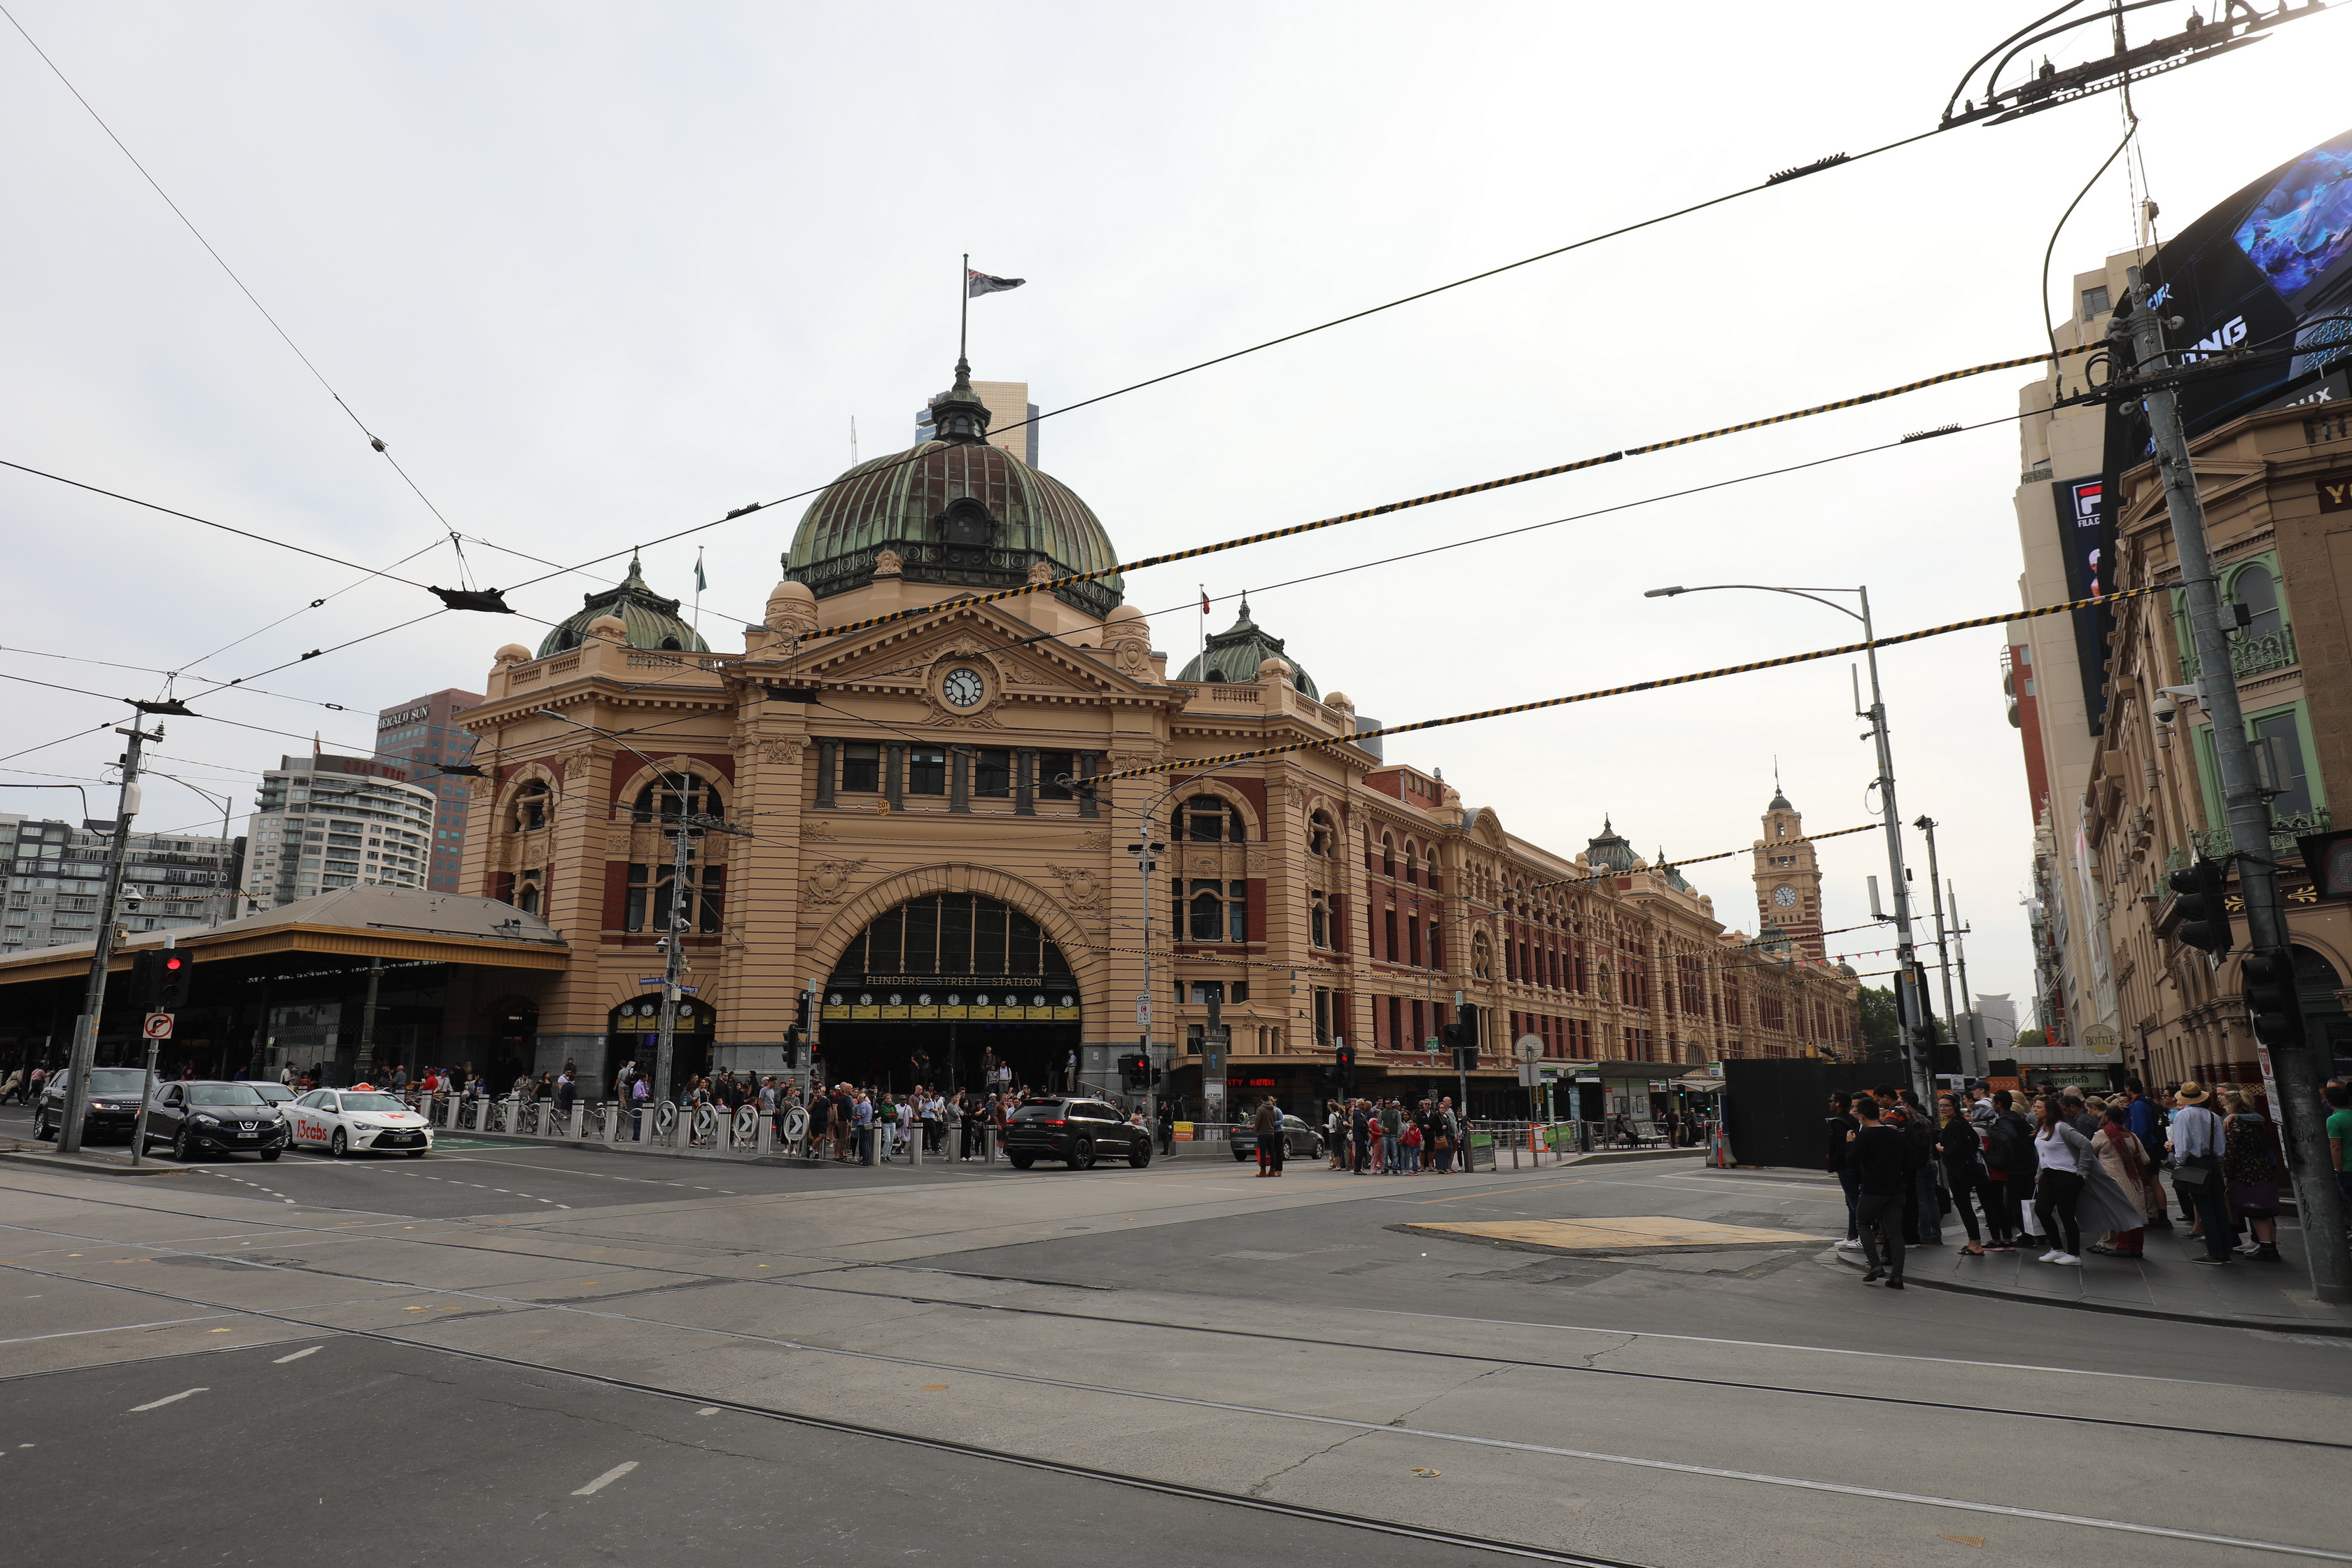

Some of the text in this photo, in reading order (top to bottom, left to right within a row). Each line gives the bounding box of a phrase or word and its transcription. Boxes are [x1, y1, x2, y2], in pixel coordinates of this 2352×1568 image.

[2325, 483, 2352, 504] Y
[378, 706, 428, 729] HERALD SUN
[343, 760, 406, 782] QUAY WEST
[866, 976, 1042, 987] FLINDERS STREET STATION
[2085, 1035, 2116, 1046] BOTTLE
[297, 1119, 327, 1142] 13cabs
